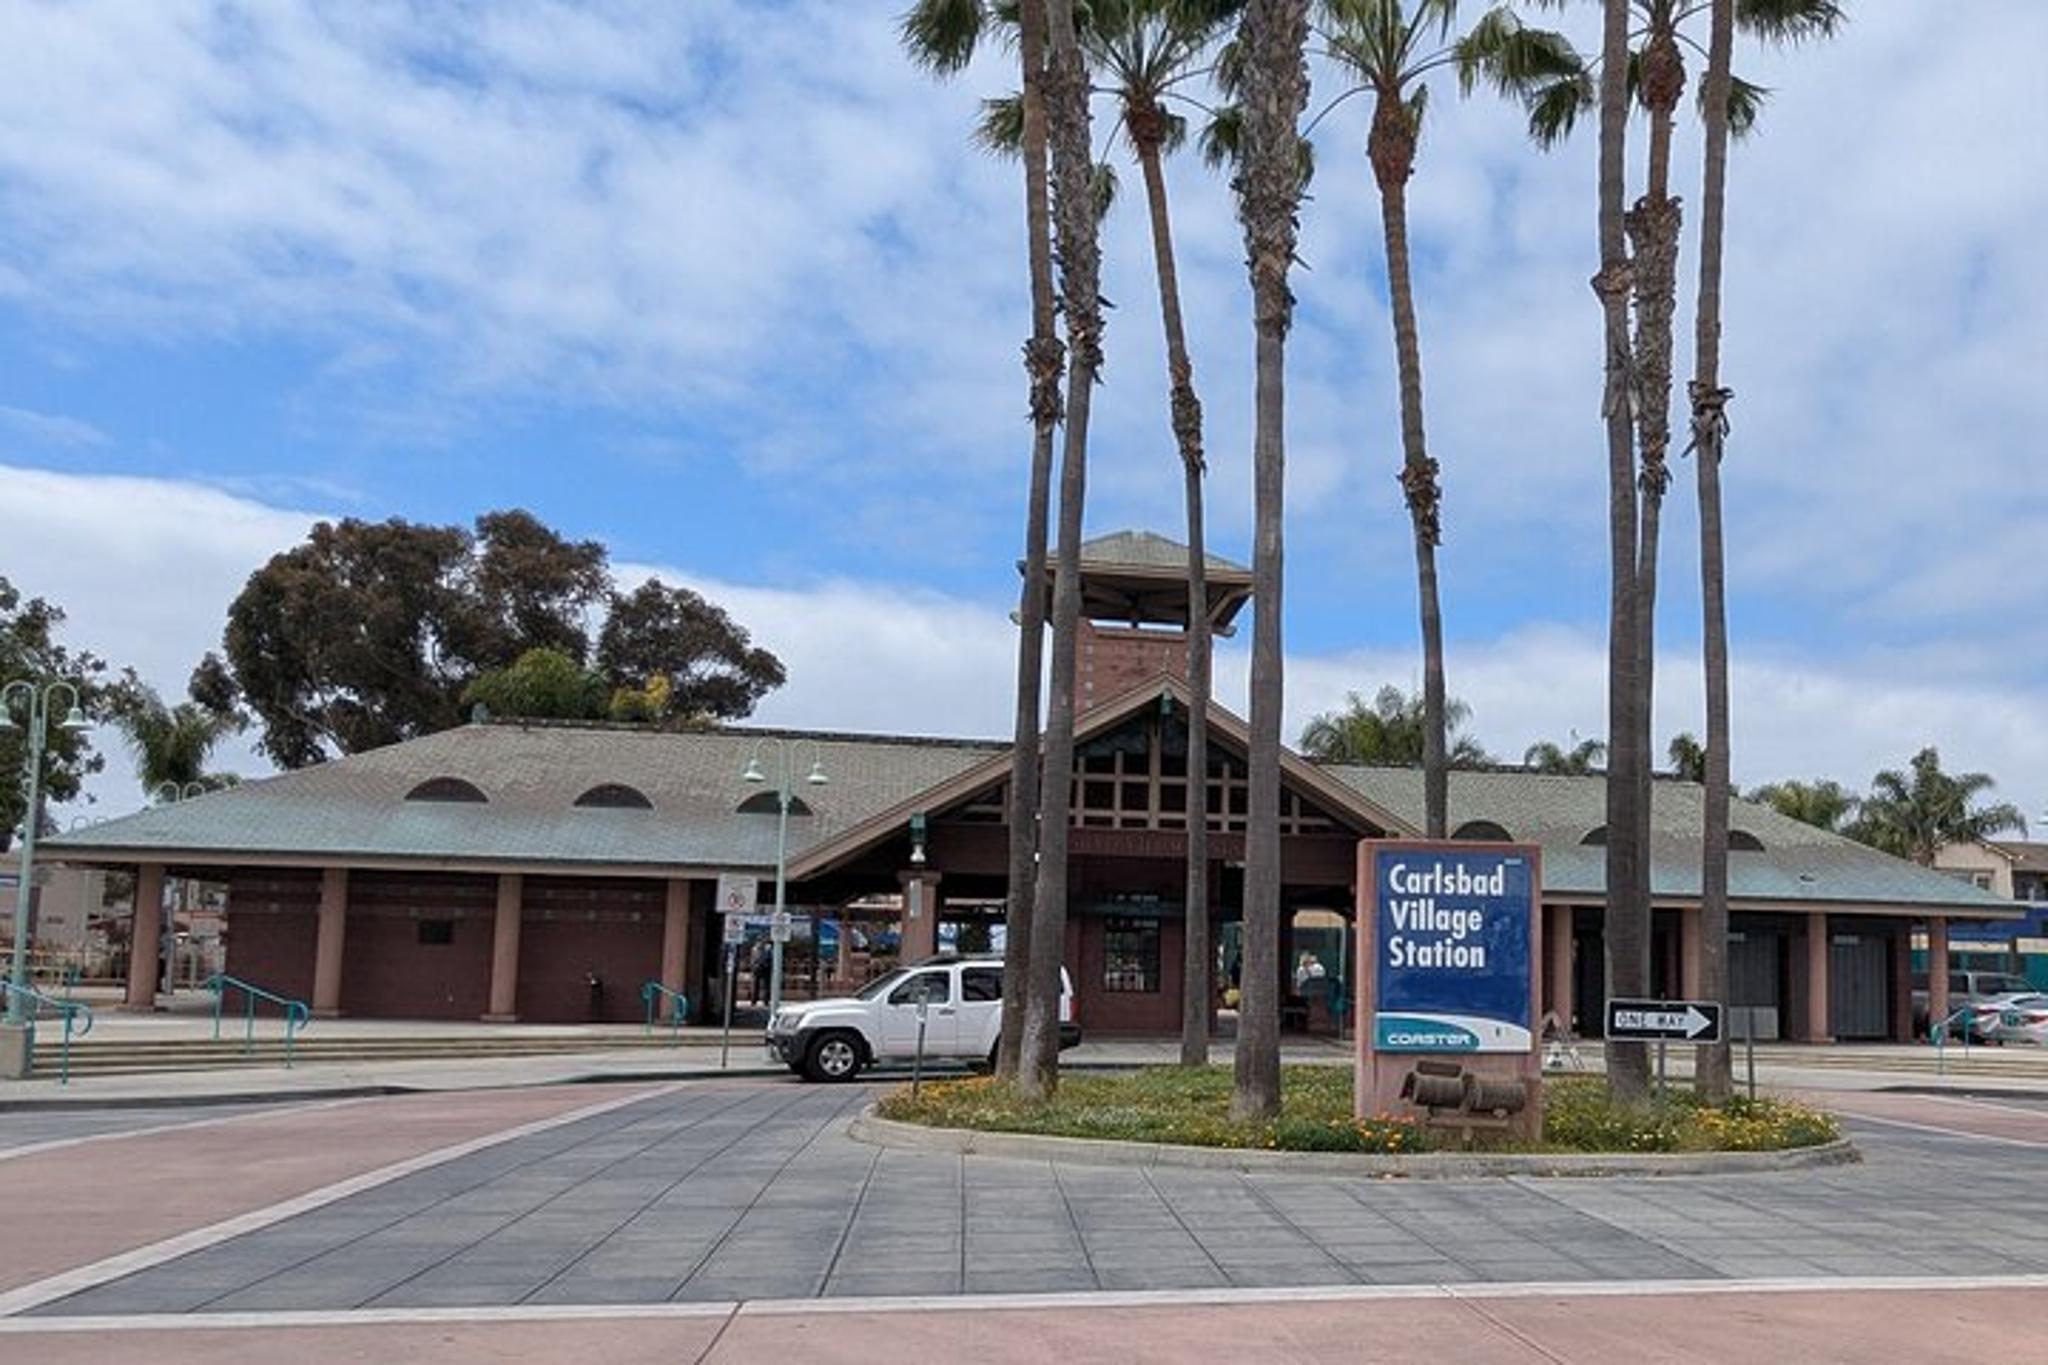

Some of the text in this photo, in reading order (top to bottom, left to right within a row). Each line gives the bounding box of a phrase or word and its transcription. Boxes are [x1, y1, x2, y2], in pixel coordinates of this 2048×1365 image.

[1389, 863, 1504, 896] Carlsbad
[1389, 899, 1483, 939] Village
[1389, 936, 1485, 968] Station
[1618, 1013, 1686, 1028] ONE WAY
[1387, 1033, 1471, 1045] COASTER
